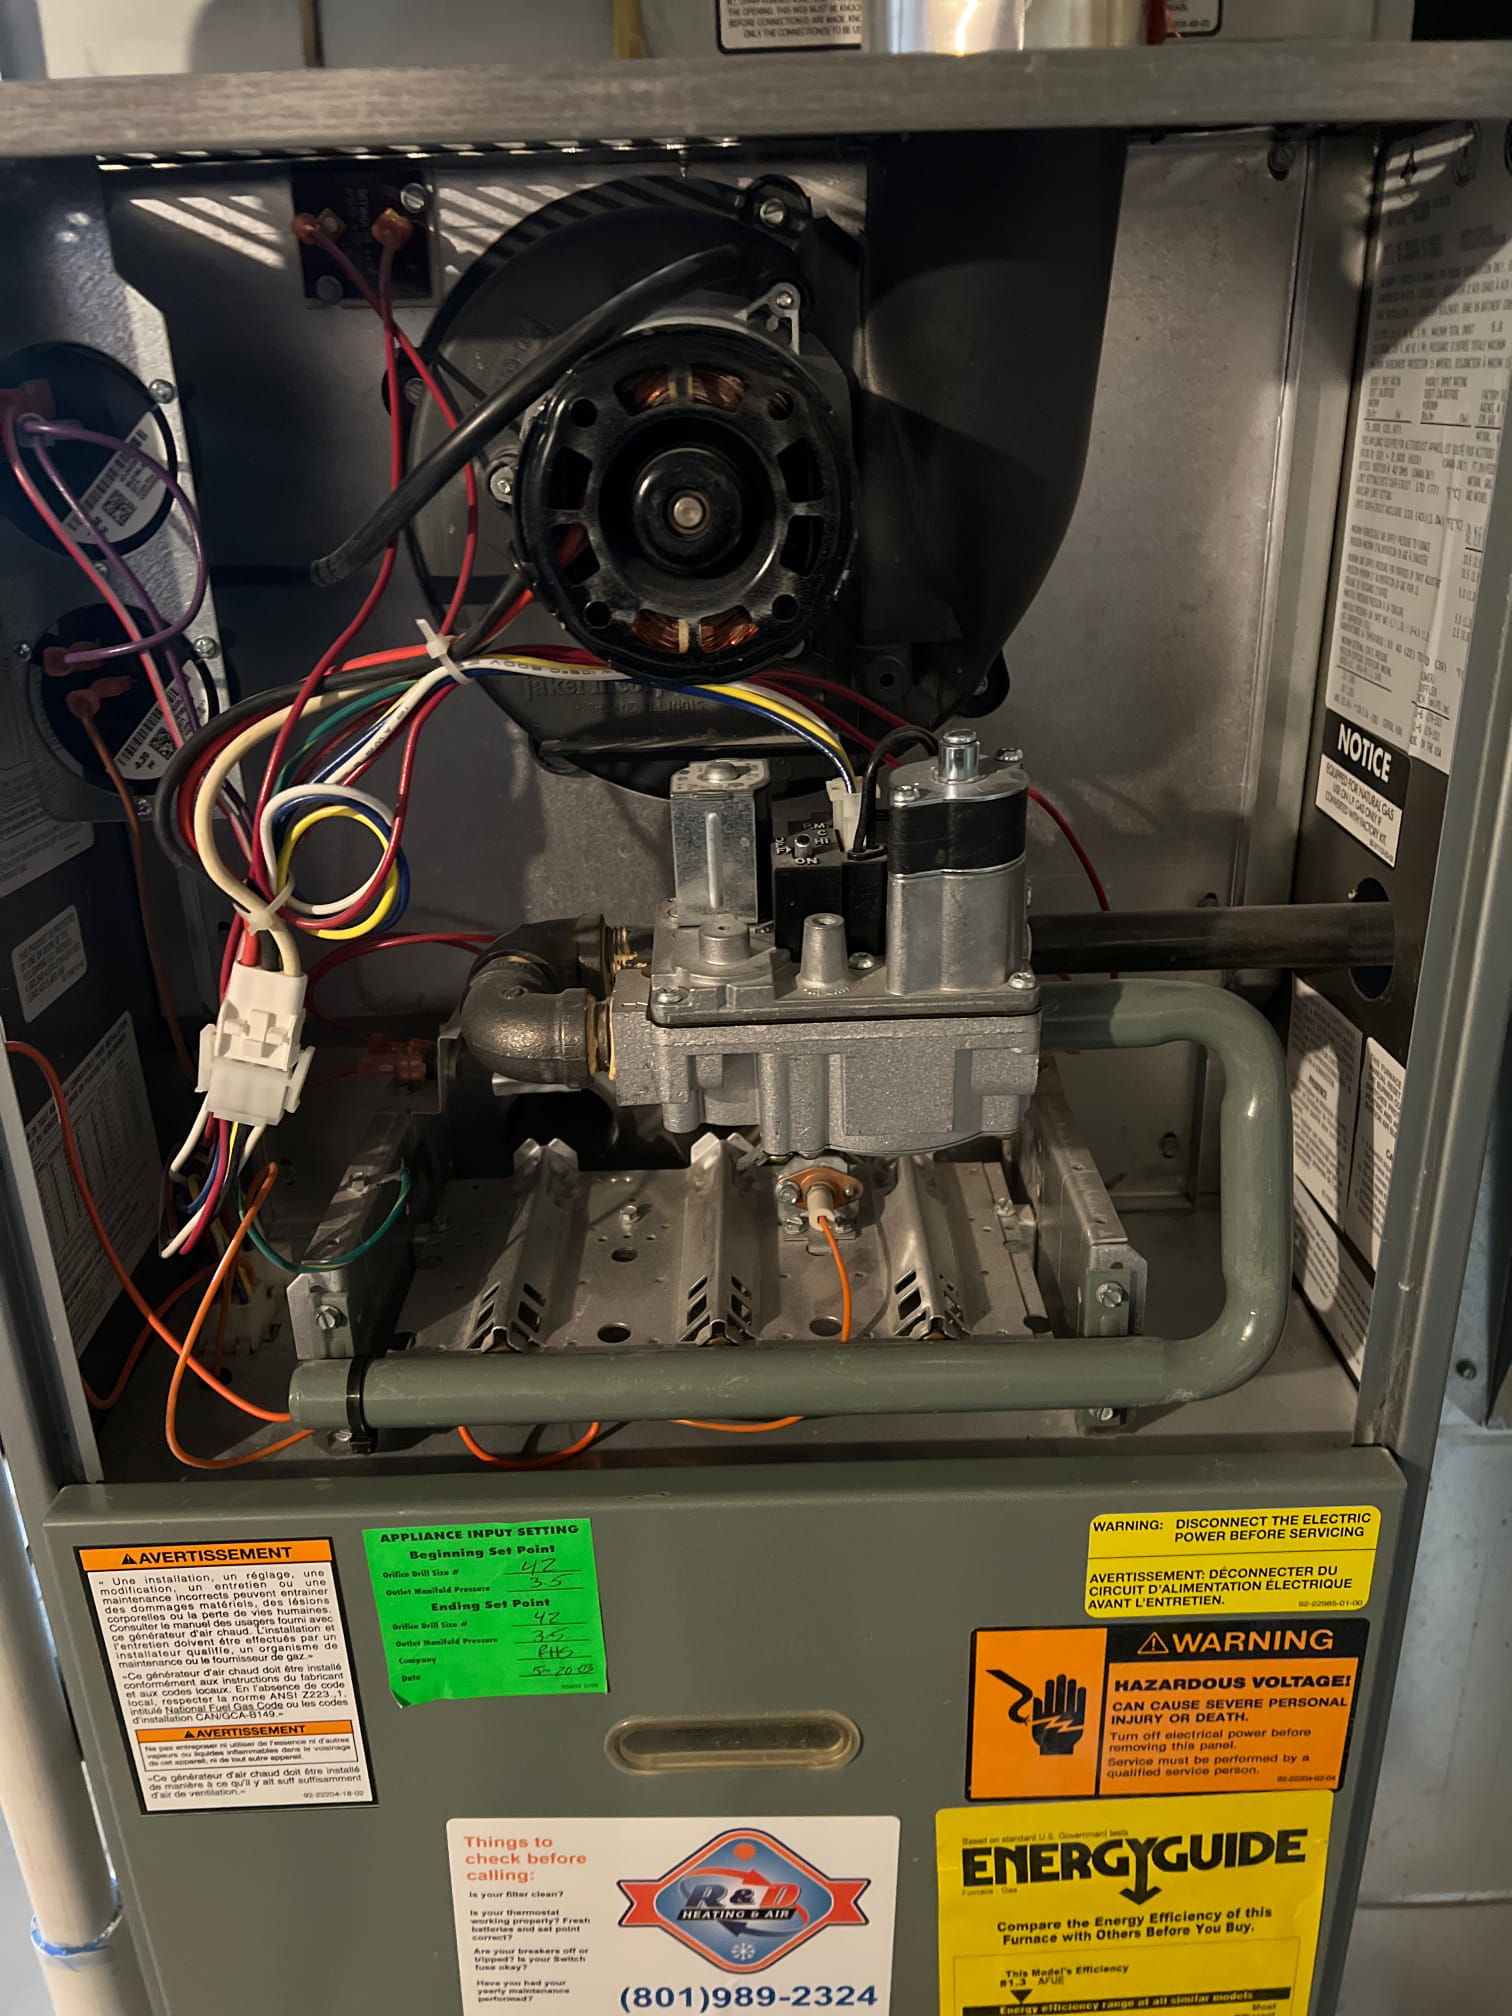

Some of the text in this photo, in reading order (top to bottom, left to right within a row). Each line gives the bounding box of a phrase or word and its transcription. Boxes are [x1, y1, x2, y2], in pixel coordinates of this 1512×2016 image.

[1338, 723, 1393, 783] NOTICE
[1382, 804, 1394, 821] GAS
[1093, 1513, 1372, 1532] WARNING: DISCONNECT THE ELECTRIC
[381, 1525, 579, 1543] APPLIANCE INPUT SETTING
[1175, 1527, 1364, 1543] POWER BEFORE SERVICING
[139, 1547, 292, 1564] AVERTISSEMENT
[410, 1545, 555, 1561] Beginning Set Point
[521, 1558, 556, 1576] 42
[112, 1578, 136, 1586] Une
[145, 1574, 214, 1584] installation,
[247, 1571, 294, 1581] réglage,
[304, 1570, 325, 1578] une
[1090, 1566, 1338, 1584] AVERTISSEMENT: DÉCONNECTER DU
[101, 1586, 176, 1596] modification,
[189, 1584, 203, 1592] un
[215, 1581, 267, 1590] entretien
[306, 1579, 326, 1587] une
[1089, 1578, 1353, 1597] CIRCUIT D'ALIMENTATION ÉLECTRIQUE
[432, 1599, 550, 1612] Ending Set Point
[1088, 1596, 1225, 1609] AVANT L'ENTRETIEN.
[421, 1622, 438, 1630] Drill
[534, 1612, 561, 1626] 42
[1172, 1629, 1334, 1653] WARNING
[399, 1657, 437, 1665] Company
[1115, 1675, 1351, 1692] HAZARDOUS VOLTAGE!
[166, 1706, 206, 1714] National
[209, 1704, 231, 1713] Fuel
[257, 1702, 284, 1710] Code
[302, 1700, 316, 1708] les
[1113, 1697, 1347, 1712] CAN CAUSE SEVERE PERSONAL
[1111, 1712, 1249, 1725] INJURY OR DEATH.
[197, 1725, 306, 1738] AVERTISSEMENT
[1111, 1728, 1312, 1741] Turn off electrical power before
[1109, 1741, 1237, 1753] removing this panel.
[1108, 1757, 1153, 1766] Service
[1158, 1756, 1189, 1765] must
[1194, 1755, 1209, 1764] be
[1214, 1754, 1279, 1765] performed
[1283, 1754, 1297, 1764] by
[1107, 1766, 1260, 1778] qualified service person.
[464, 1836, 553, 1851] Things to
[465, 1853, 587, 1865] check before
[962, 1829, 1309, 1896] ENERGYGUIDE
[467, 1870, 535, 1883] calling:
[481, 1891, 503, 1899] your
[471, 1918, 510, 1926] working
[682, 1910, 745, 1919] HEATING
[765, 1910, 789, 1919] AIR
[998, 1907, 1272, 1933] Compare the Energy Efficiency of this
[1003, 1922, 1254, 1946] Furnace with Others Before You Buy.
[1006, 1965, 1129, 1979] This Model's Efficiency
[1038, 1976, 1064, 1986] AFUE
[620, 1985, 878, 2014] (801)989-2324
[1000, 1991, 1253, 2016] Energy efficiency range of all similar models
